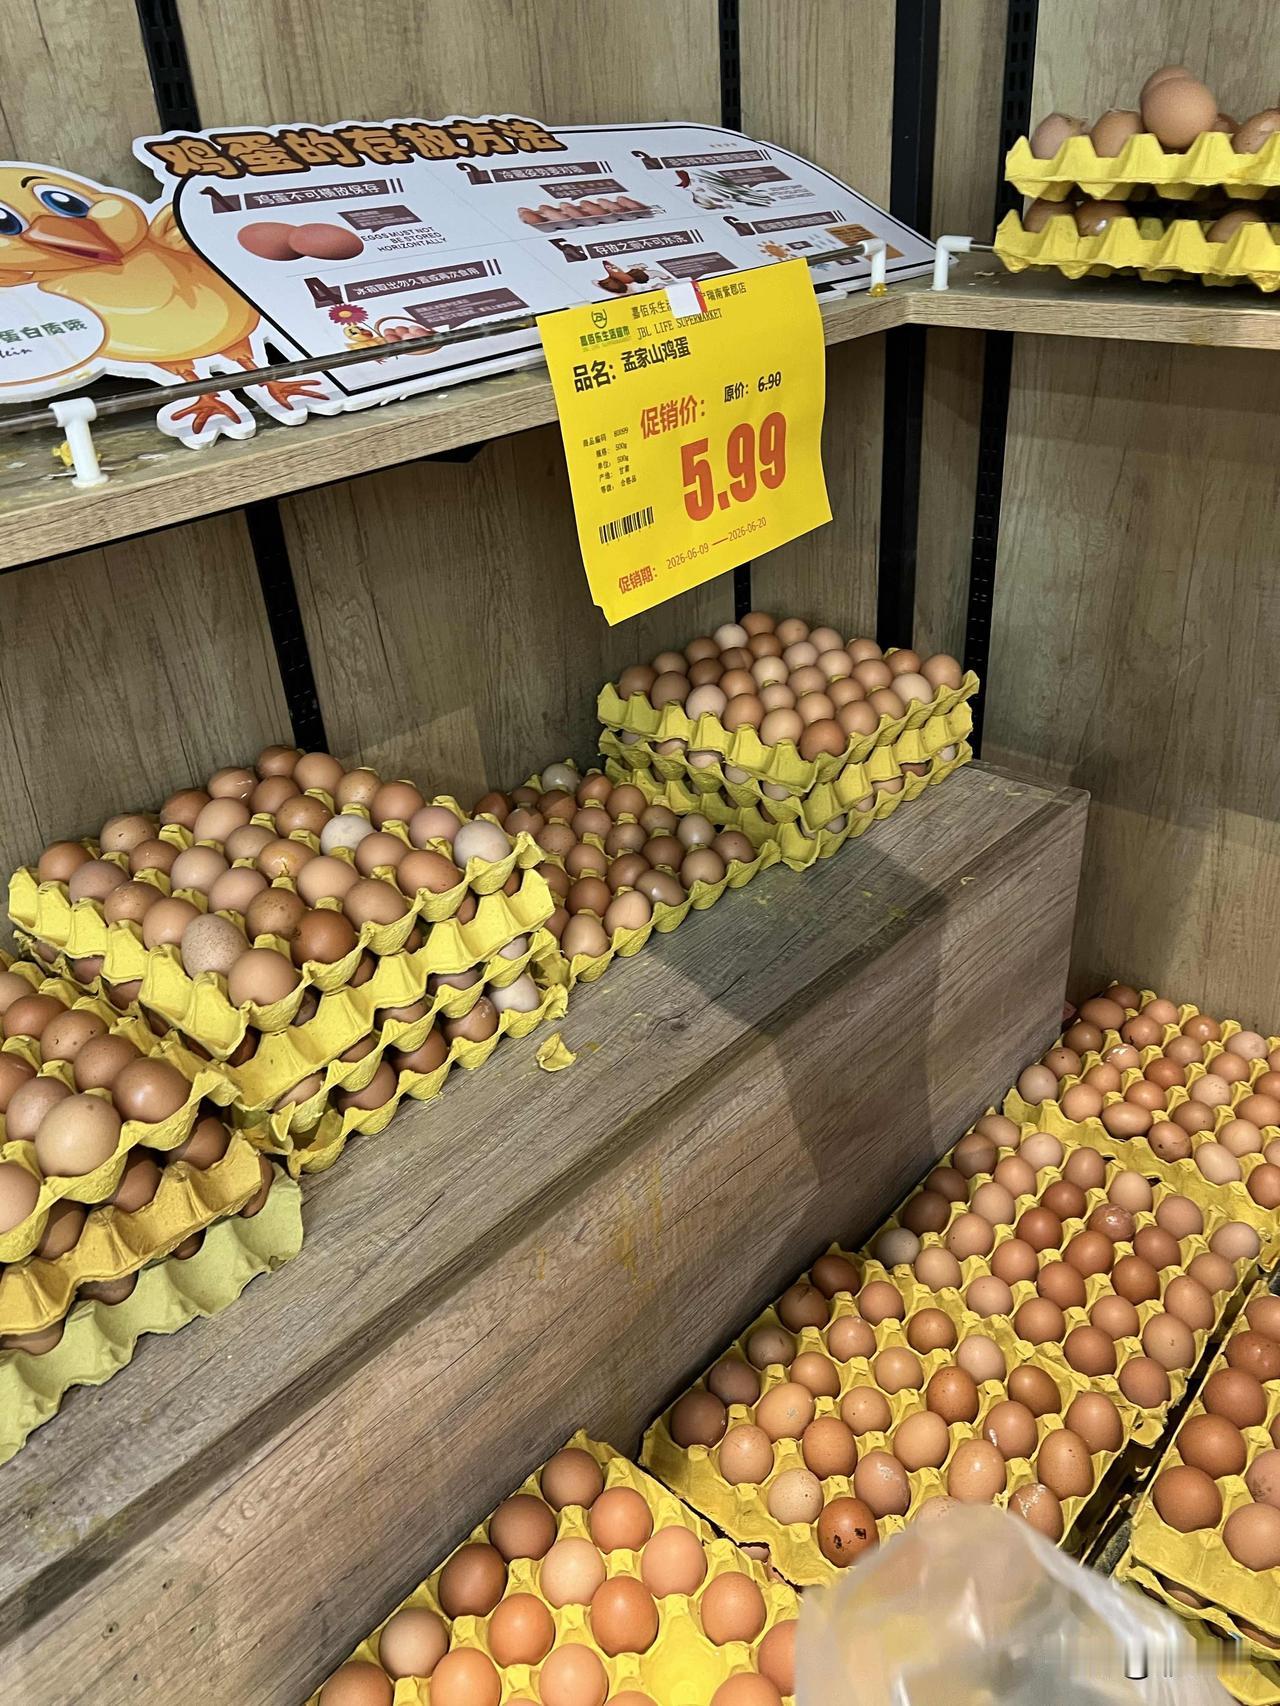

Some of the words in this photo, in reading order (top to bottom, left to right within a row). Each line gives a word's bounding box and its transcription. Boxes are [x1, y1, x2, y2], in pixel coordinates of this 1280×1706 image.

[145, 119, 567, 178] 鸡蛋的存放方法
[361, 233, 389, 241] EGGS
[389, 229, 414, 237] MUST
[415, 226, 435, 234] NOT
[377, 237, 447, 252] HORIZONTALLY
[404, 232, 442, 241] STORED
[637, 326, 652, 340] JBL
[654, 320, 674, 334] LIFE
[676, 308, 722, 329] SUPERMARKET
[621, 336, 691, 373] 孟家山鸡蛋
[680, 411, 787, 521] 5.99
[667, 543, 709, 570] 2026-06-09
[729, 516, 767, 542] 2026-06-20
